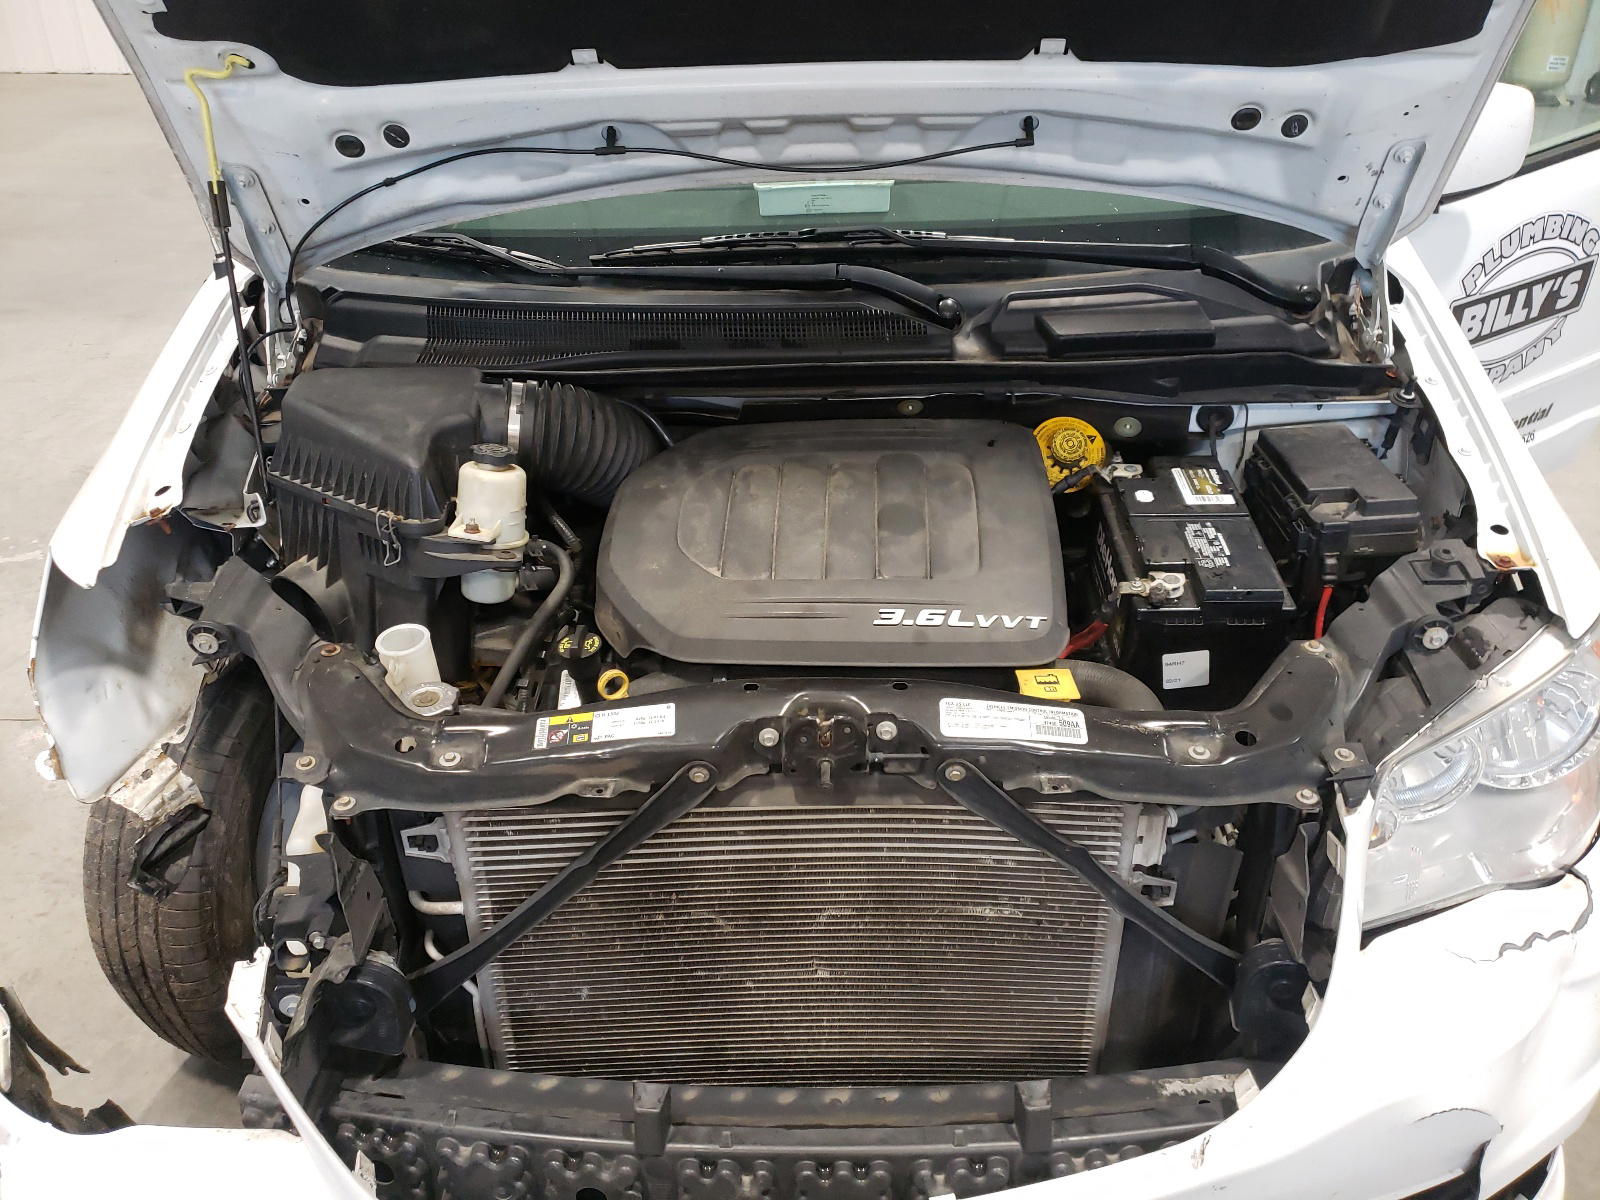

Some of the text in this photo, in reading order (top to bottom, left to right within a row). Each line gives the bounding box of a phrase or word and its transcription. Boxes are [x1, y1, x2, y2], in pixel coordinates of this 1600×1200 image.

[1461, 213, 1600, 296] PLUMBING
[1460, 269, 1584, 342] BILLY'S
[1485, 315, 1568, 384] PANY
[872, 608, 1049, 630] 3.6L VVT
